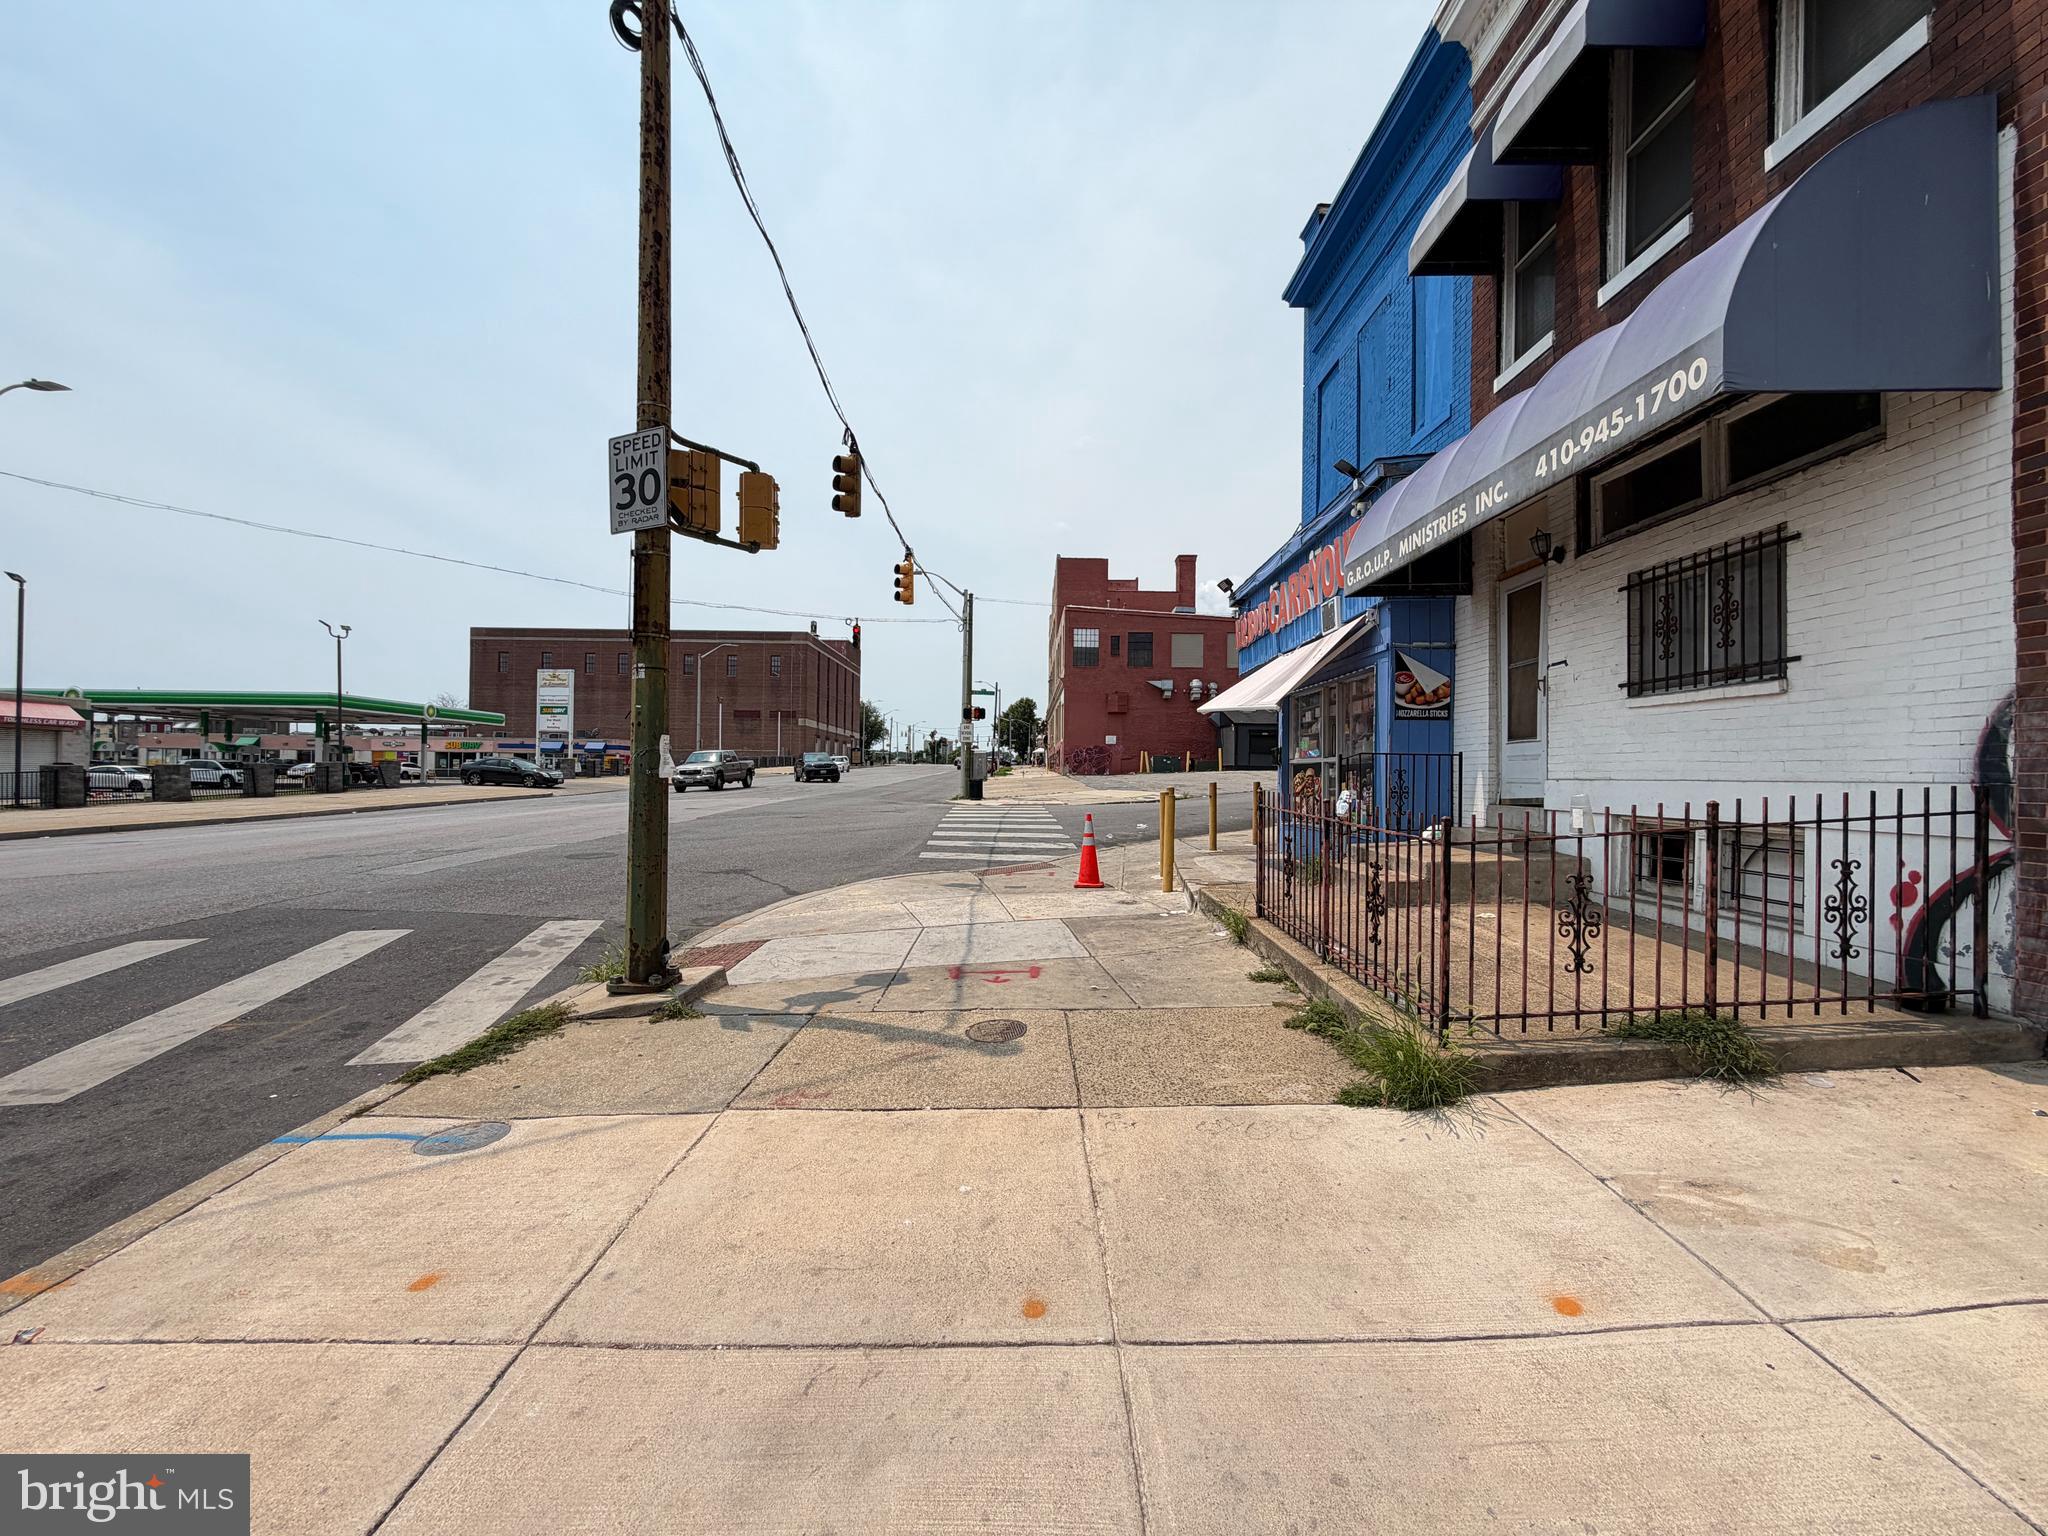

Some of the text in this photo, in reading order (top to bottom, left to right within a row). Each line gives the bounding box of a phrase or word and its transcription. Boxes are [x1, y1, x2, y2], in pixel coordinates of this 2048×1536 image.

[613, 433, 661, 456] SPEED
[616, 450, 658, 472] LIMIT
[1346, 357, 1709, 587] G.R.O.U.P. MINISTRIES INC. 410-945-1700
[614, 468, 661, 510] 30
[618, 507, 658, 519] CHECKED
[631, 514, 659, 524] RADAR
[1430, 710, 1448, 718] STICKS
[445, 741, 482, 749] SUBWAY
